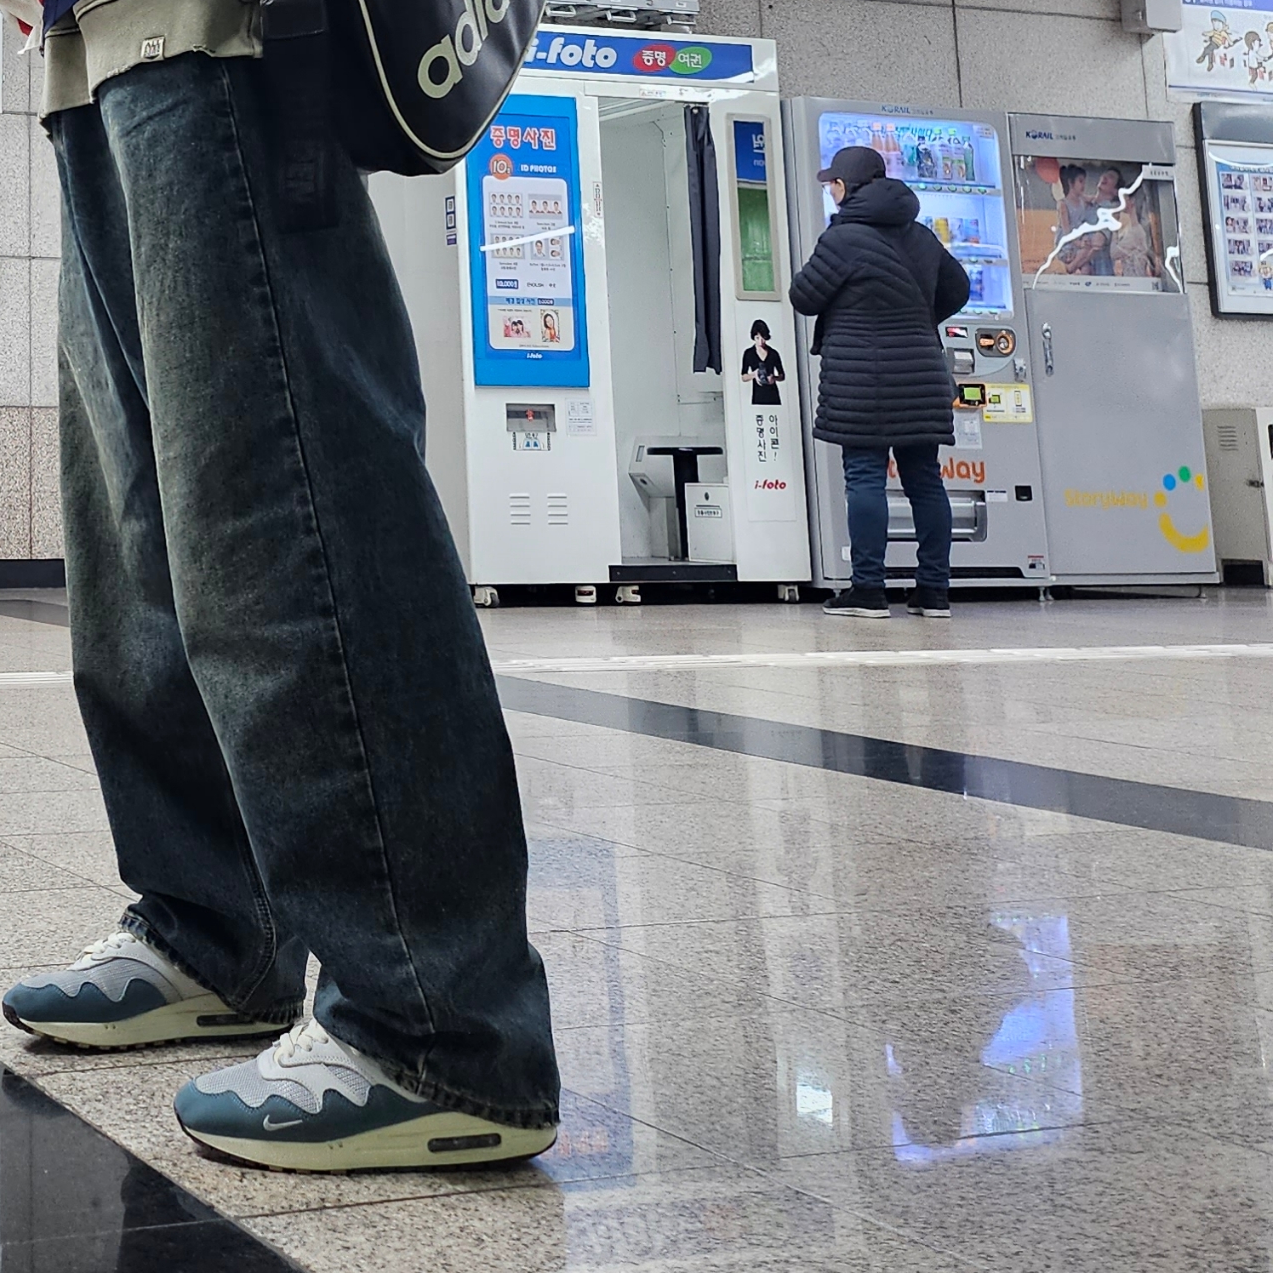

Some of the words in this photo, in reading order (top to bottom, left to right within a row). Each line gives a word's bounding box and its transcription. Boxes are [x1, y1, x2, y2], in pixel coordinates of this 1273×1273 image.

[526, 37, 617, 68] i-foto
[678, 53, 702, 68] 여권
[490, 125, 556, 150] 증명사진
[755, 479, 786, 489] i-foto
